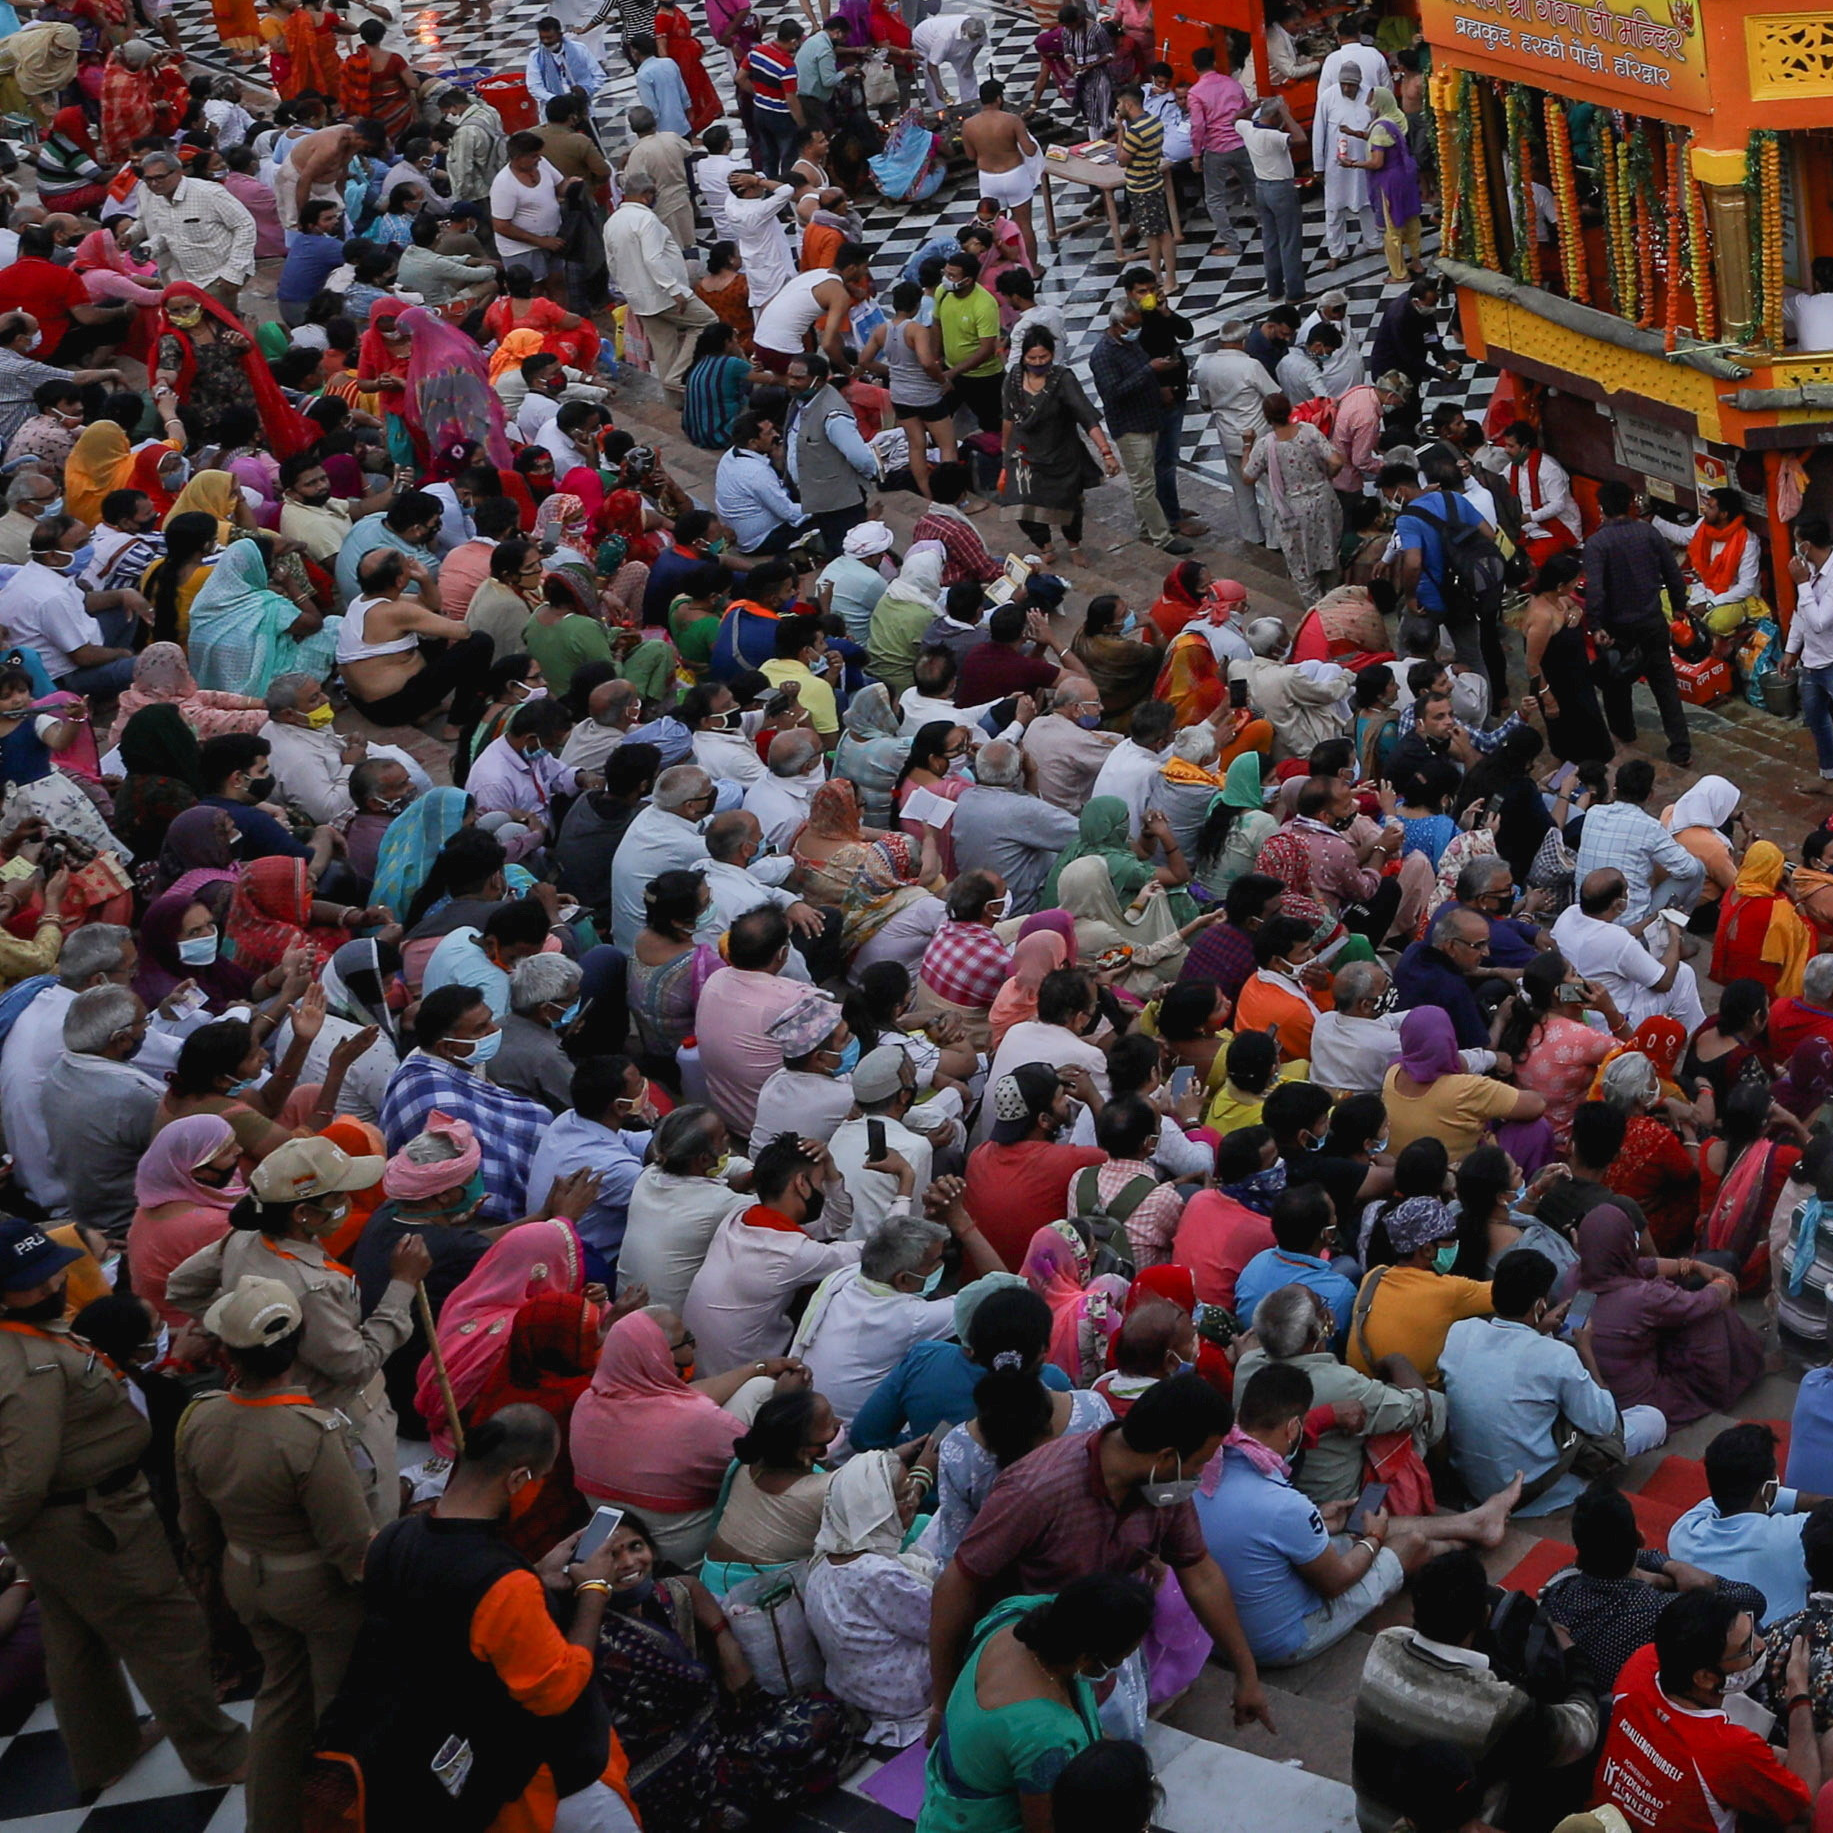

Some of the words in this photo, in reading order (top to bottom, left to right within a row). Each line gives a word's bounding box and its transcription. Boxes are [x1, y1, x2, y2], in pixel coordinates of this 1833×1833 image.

[1520, 31, 1566, 62] हरकी
[1613, 52, 1672, 90] हरिद्वार
[1585, 0, 1614, 43] जी
[1616, 9, 1686, 62] मन्दिर
[1309, 1511, 1324, 1535] 5
[1619, 1718, 1685, 1782] #CHALLENGEYOURSELF
[1618, 1768, 1665, 1810] HYDERABAD
